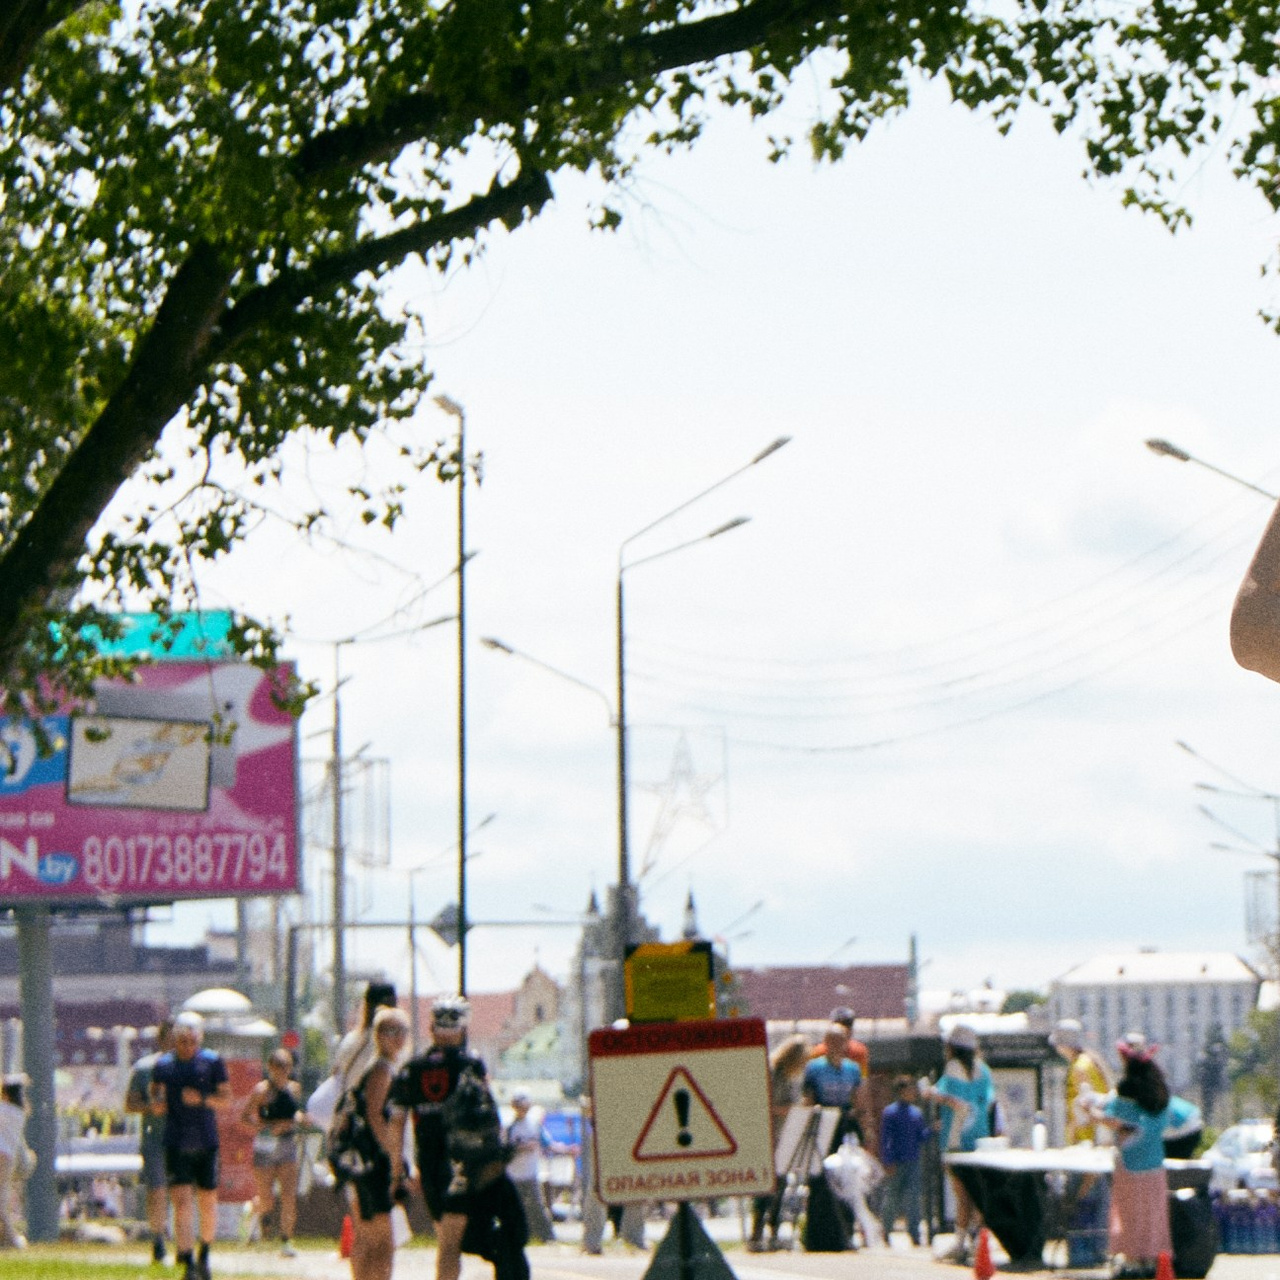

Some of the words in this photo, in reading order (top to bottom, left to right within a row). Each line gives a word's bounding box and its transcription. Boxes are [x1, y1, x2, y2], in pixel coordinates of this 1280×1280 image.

[82, 832, 288, 885] 80173887794
[606, 1170, 701, 1193] ОПАСНАЯ
[705, 1168, 757, 1187] ЗОНА
